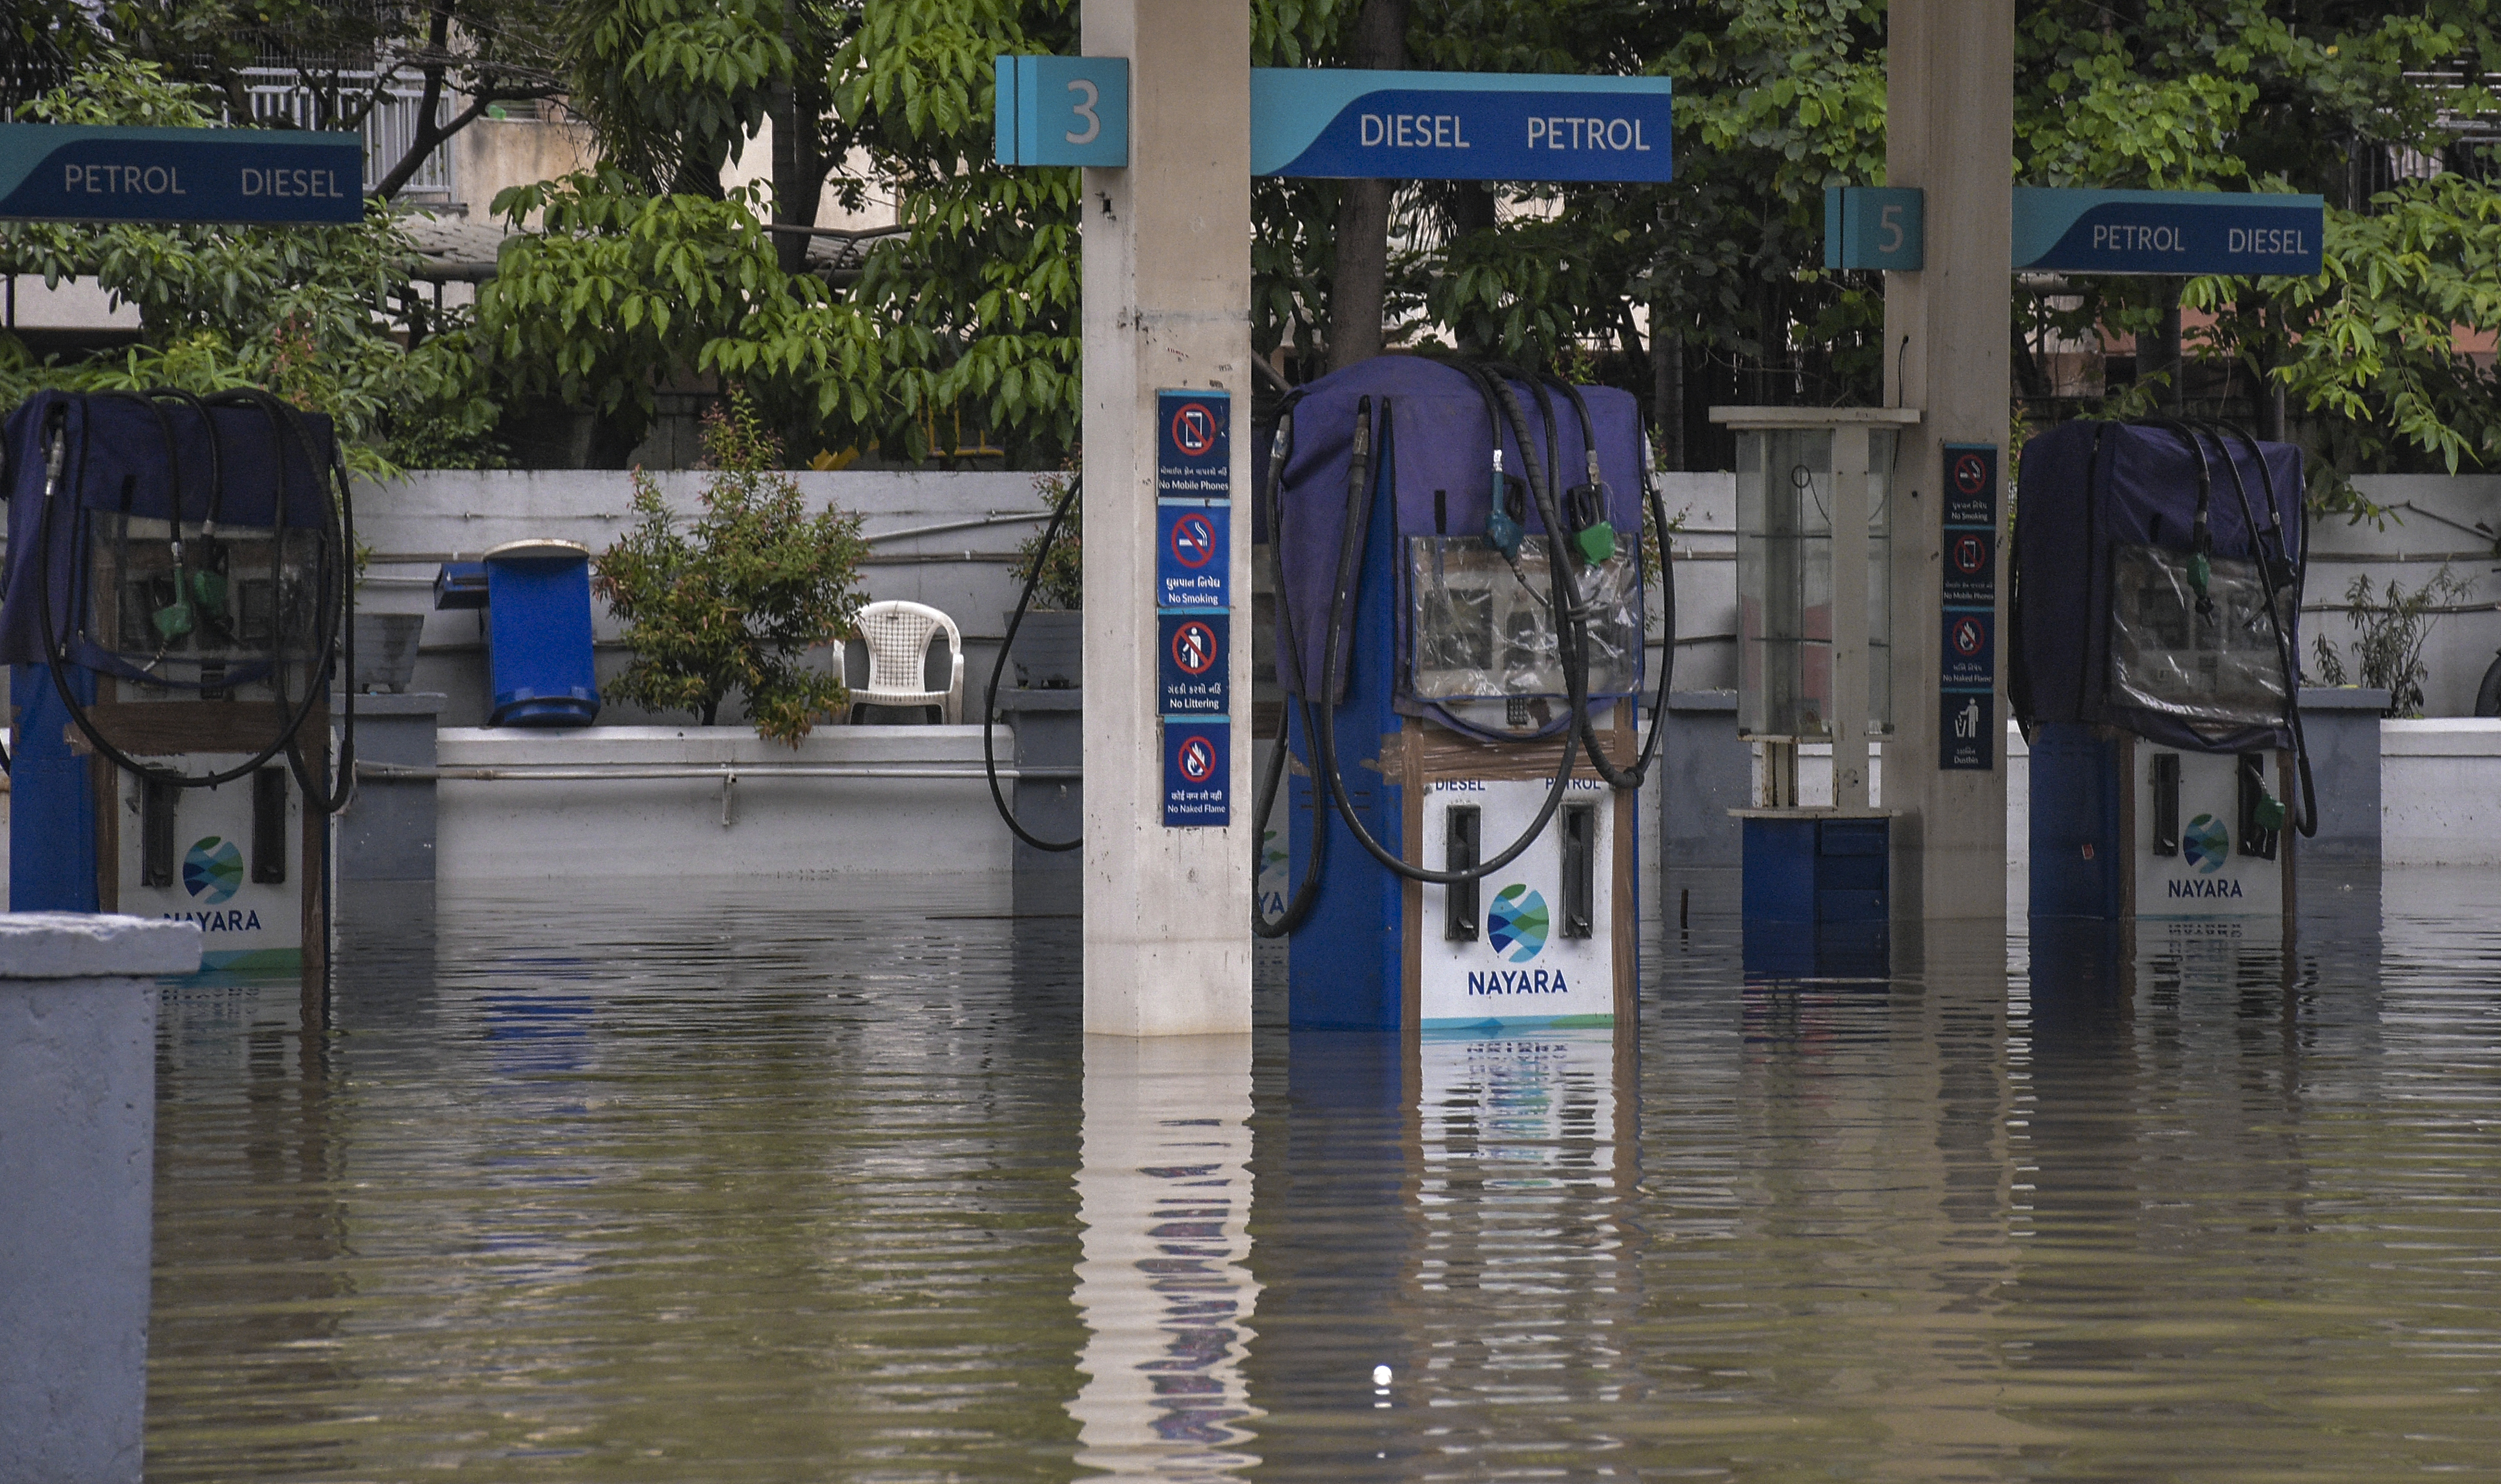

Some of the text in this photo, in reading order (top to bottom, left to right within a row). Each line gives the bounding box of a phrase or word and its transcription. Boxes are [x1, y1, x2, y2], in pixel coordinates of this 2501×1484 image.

[1065, 79, 1100, 144] 3
[1360, 114, 1651, 151] DIESEL PETROL
[65, 164, 344, 198] PETROL DIESEL
[1878, 204, 1904, 253] 5
[2093, 225, 2309, 254] PETROL DIESEL
[1158, 479, 1229, 490] No Mobile Phones
[1952, 511, 1988, 522] No Smoking
[1169, 592, 1219, 605] No Smoking
[1943, 591, 1952, 599] No
[1942, 674, 1952, 682] No
[1953, 674, 1973, 683] Naked
[1170, 697, 1219, 710] No Littering
[1954, 755, 1978, 764] Dustbin
[1168, 803, 1226, 813] No Naked Flame
[2168, 879, 2243, 898] NAYARA
[1467, 969, 1569, 996] NAYARA
